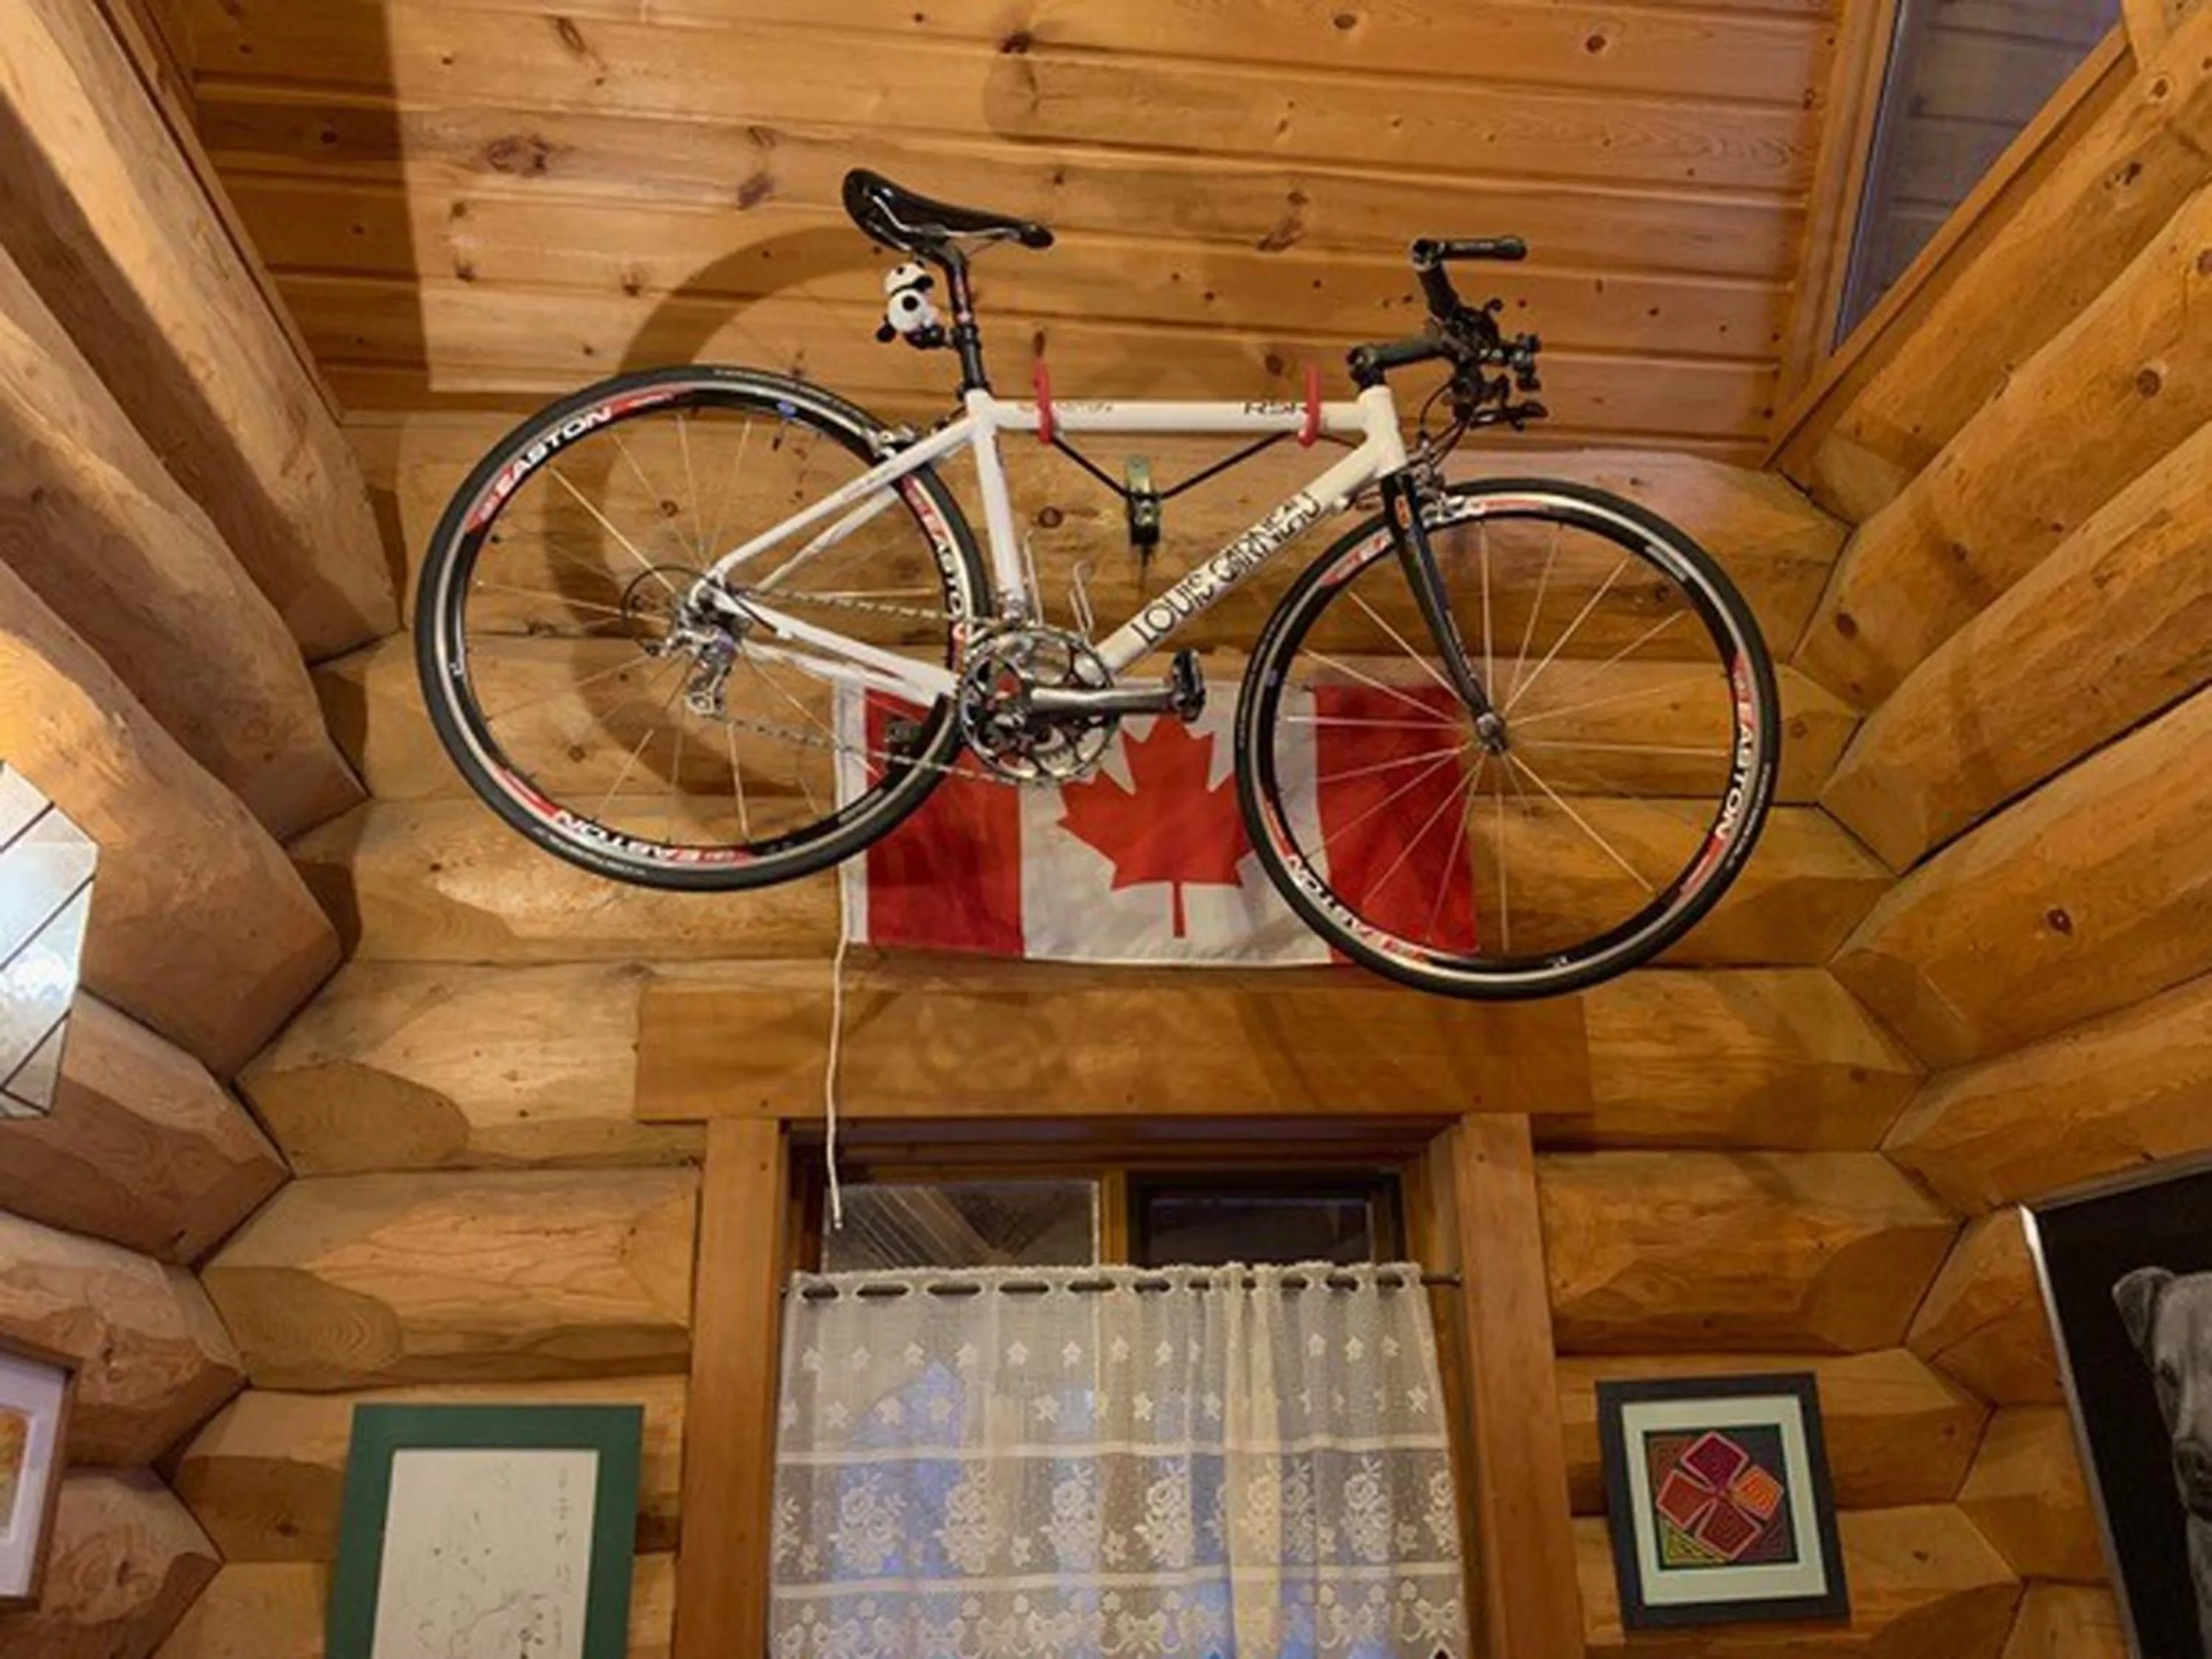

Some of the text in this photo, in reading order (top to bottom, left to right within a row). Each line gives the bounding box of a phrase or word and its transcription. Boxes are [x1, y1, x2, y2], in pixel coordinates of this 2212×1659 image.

[495, 406, 612, 498] EASTON
[1130, 573, 1216, 646] LOUIS
[1208, 490, 1321, 583] GARNEAU
[1715, 702, 1755, 840] EASTON
[556, 810, 701, 863] EASTON
